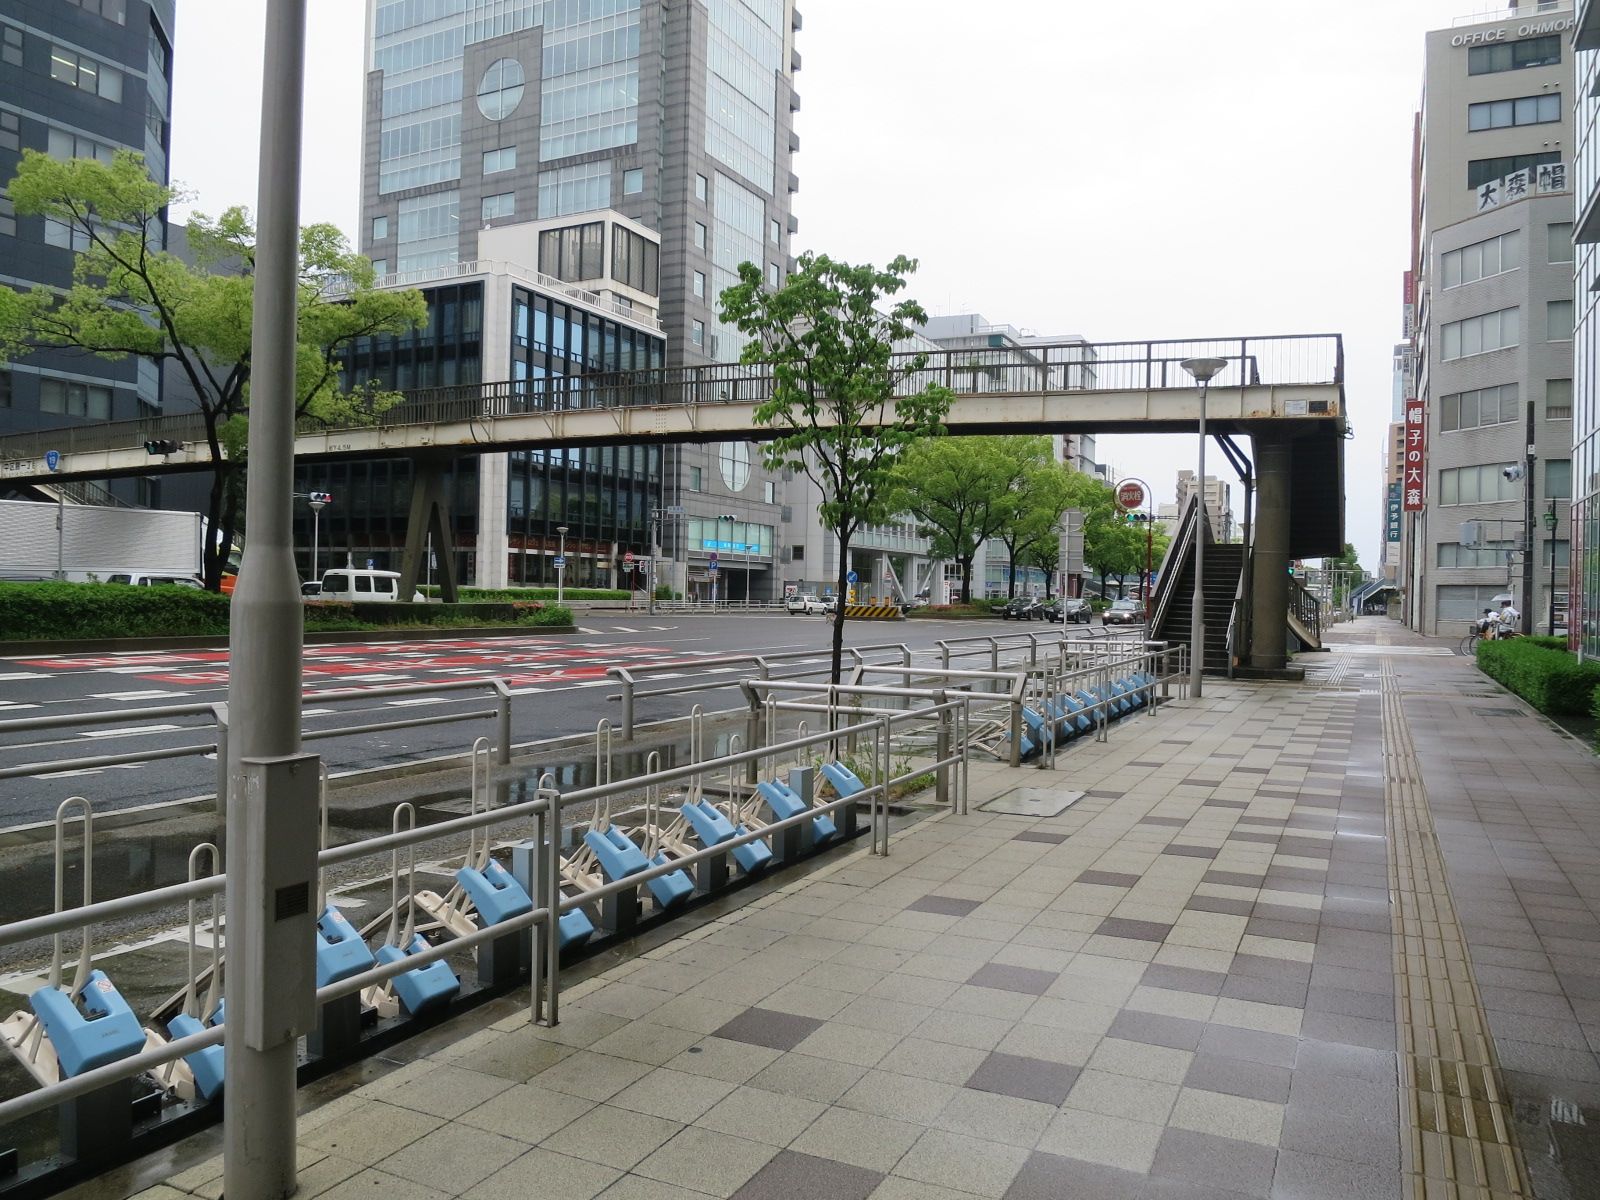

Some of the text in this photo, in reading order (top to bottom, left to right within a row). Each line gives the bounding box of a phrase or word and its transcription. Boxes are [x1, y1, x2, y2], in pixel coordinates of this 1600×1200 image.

[1451, 28, 1507, 47] OFFICE
[1407, 406, 1422, 506] 帽子の大森
[1390, 503, 1399, 538] 伊予銀行
